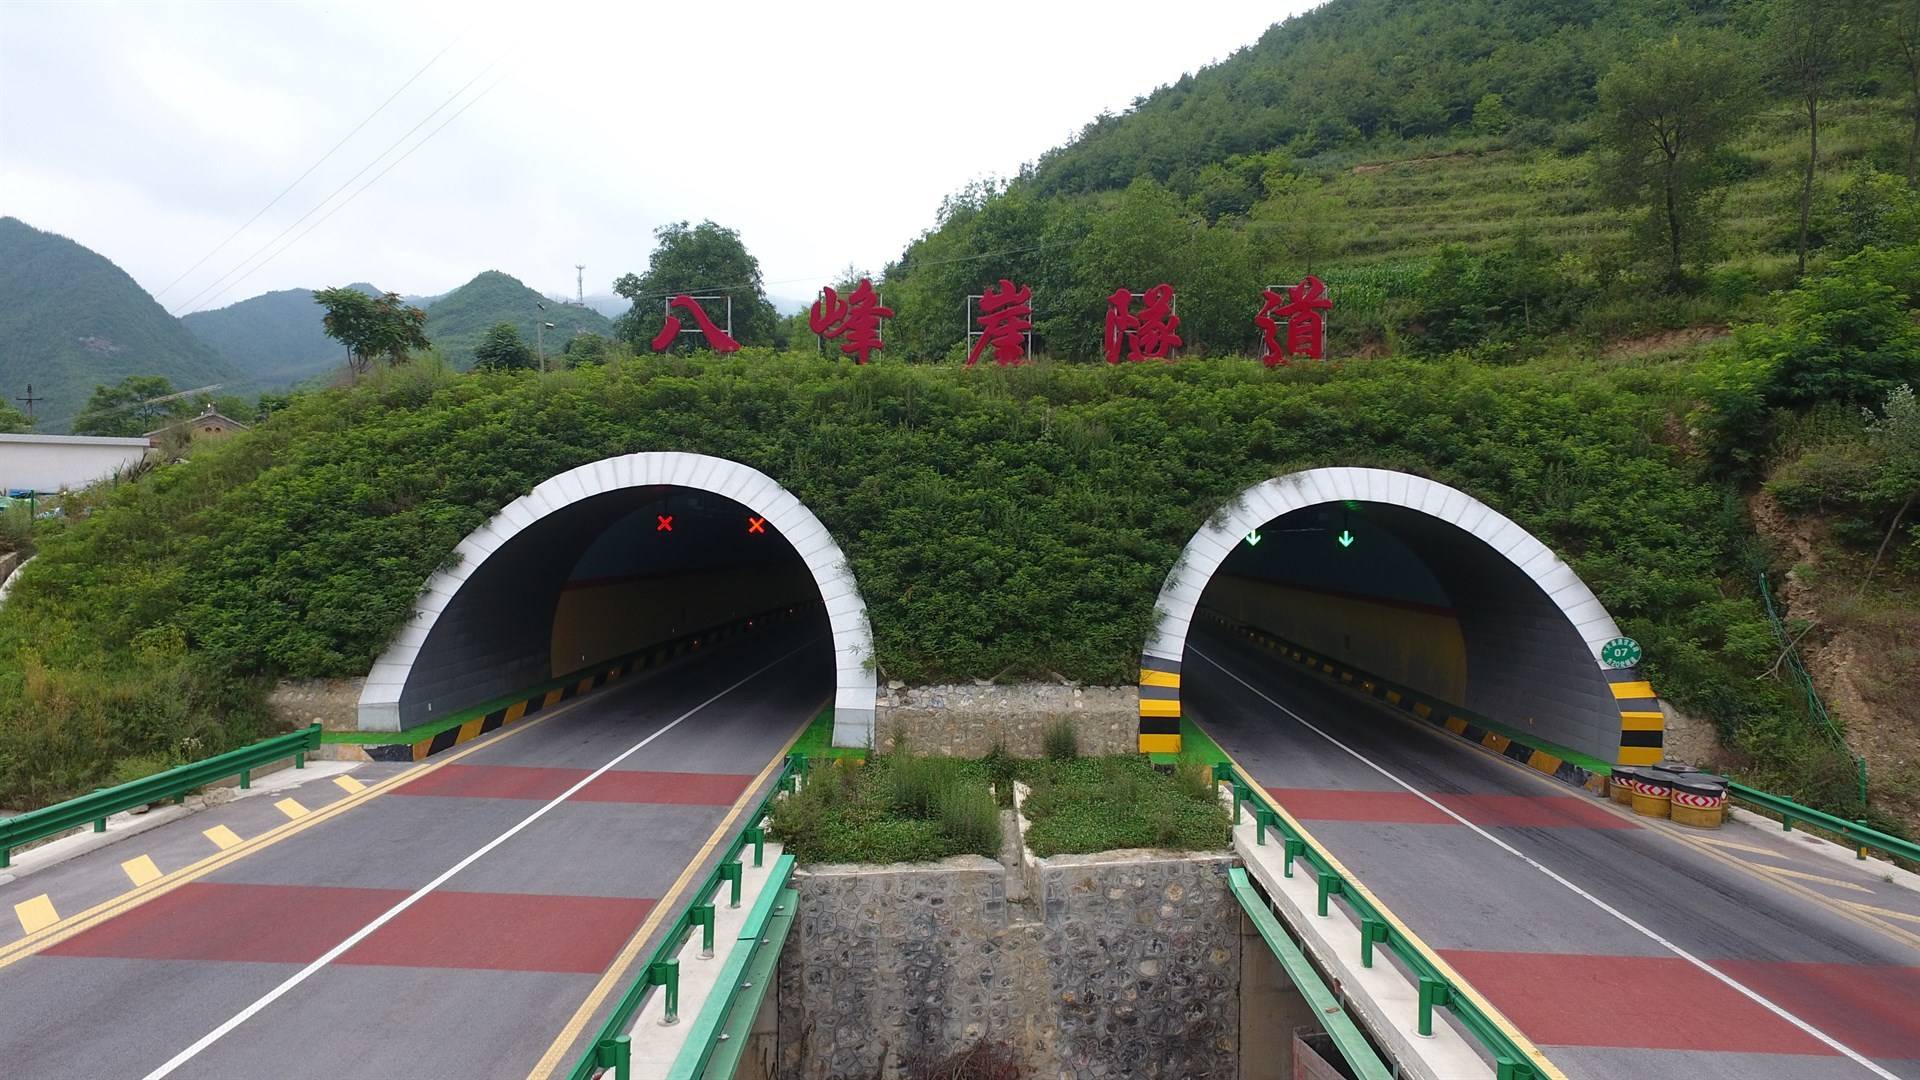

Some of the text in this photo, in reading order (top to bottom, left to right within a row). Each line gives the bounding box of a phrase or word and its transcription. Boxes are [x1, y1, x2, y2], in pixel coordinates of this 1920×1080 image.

[652, 273, 1333, 367] 八峰崖隧道
[1614, 648, 1628, 657] 07
